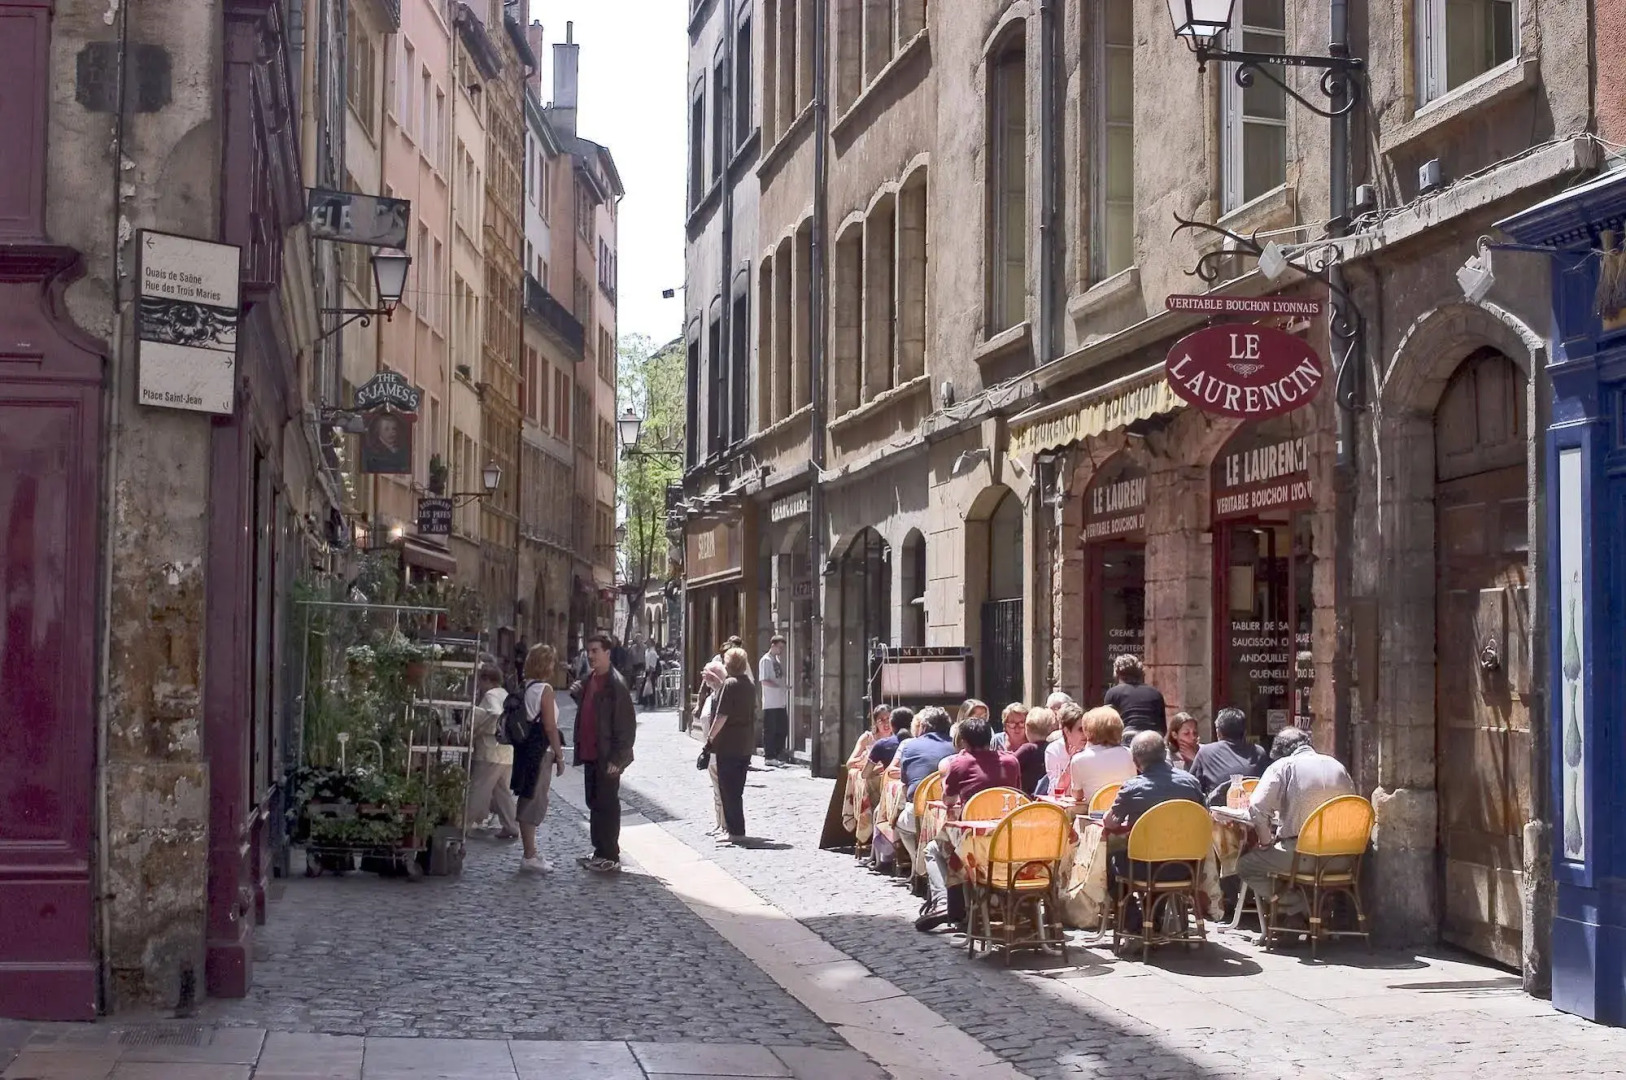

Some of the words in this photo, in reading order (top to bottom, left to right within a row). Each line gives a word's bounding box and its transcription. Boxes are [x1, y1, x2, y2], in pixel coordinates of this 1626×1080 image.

[145, 266, 167, 280] Quais
[168, 271, 178, 281] de
[179, 272, 202, 285] Saône
[145, 281, 160, 291] Rue
[161, 283, 175, 294] des
[176, 285, 194, 297] Trois
[196, 288, 221, 301] Maries
[1169, 298, 1223, 310] VERITABLE
[1226, 300, 1270, 312] BOUCHON
[1273, 302, 1319, 313] LYONNAIS
[1229, 333, 1260, 360] LE
[376, 373, 398, 383] THE
[1170, 354, 1322, 412] LAURENCIN
[143, 389, 163, 401] Place
[164, 391, 203, 405] Saint-Jean
[1226, 454, 1239, 487] LE
[1093, 487, 1103, 515] LE
[1217, 493, 1249, 515] VERITABLE
[1251, 485, 1288, 508] BOUCHON
[1111, 514, 1138, 534] BOUCHON
[1231, 621, 1260, 631] TABLIER
[1264, 621, 1275, 631] DE
[1232, 637, 1278, 647] SAUCISSON
[902, 648, 945, 656] MENU
[1258, 685, 1285, 695] TRIPES
